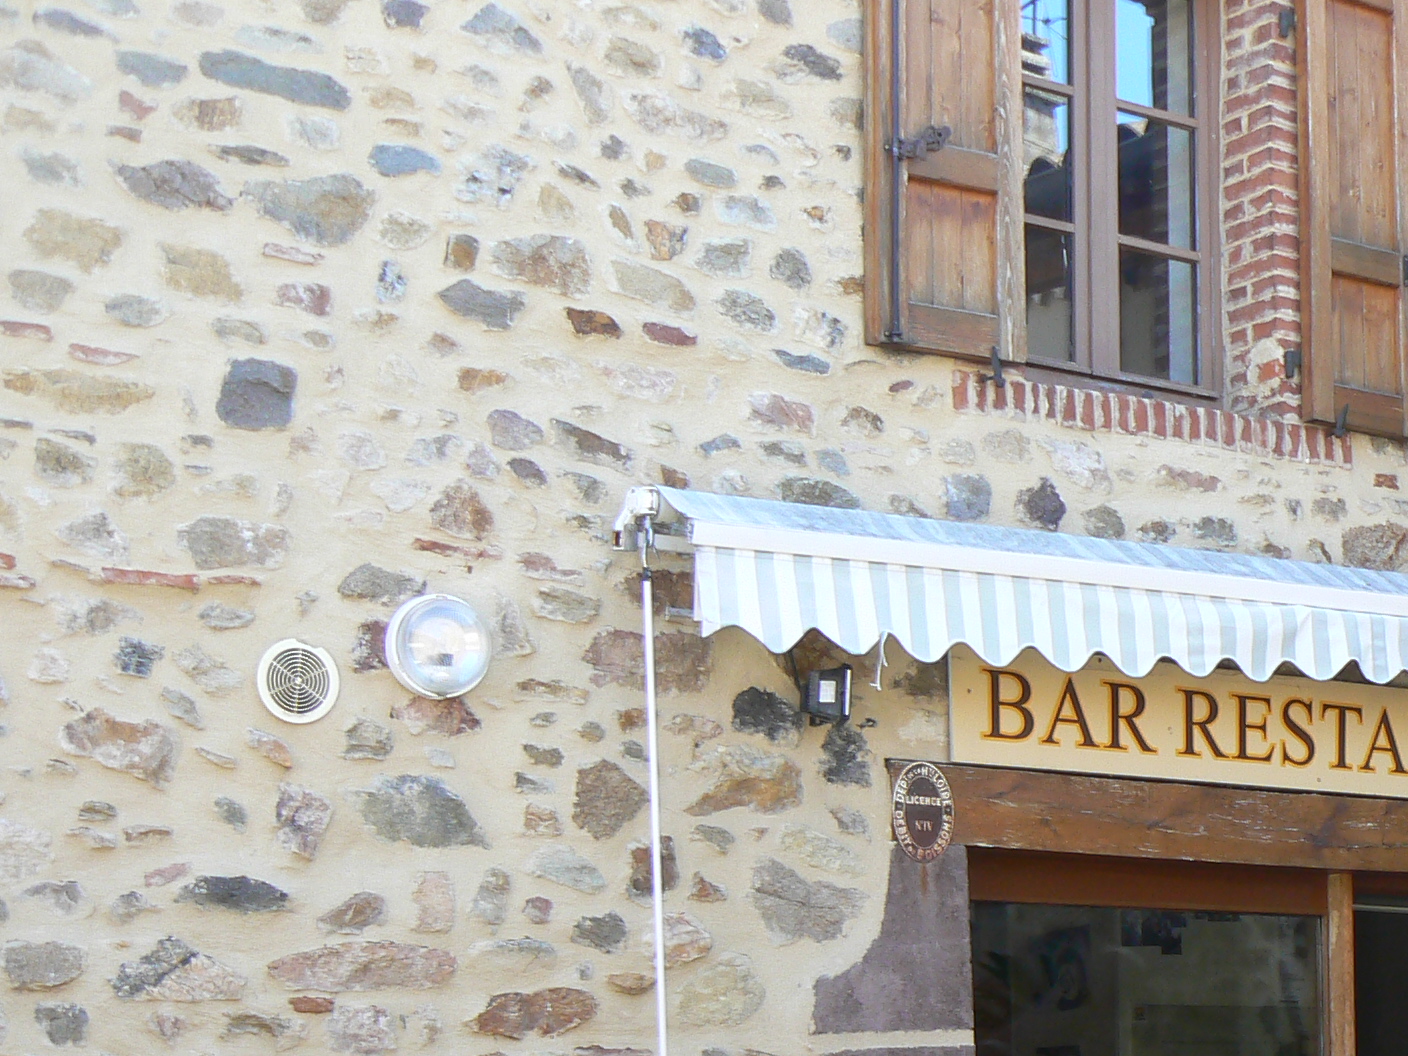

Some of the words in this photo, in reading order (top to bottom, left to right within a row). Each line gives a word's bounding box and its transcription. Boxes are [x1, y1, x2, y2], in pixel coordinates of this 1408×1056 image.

[980, 666, 1158, 754] BAR
[905, 795, 942, 807] LICENCE
[933, 773, 952, 806] LOIRE
[916, 814, 952, 860] BOISSONS
